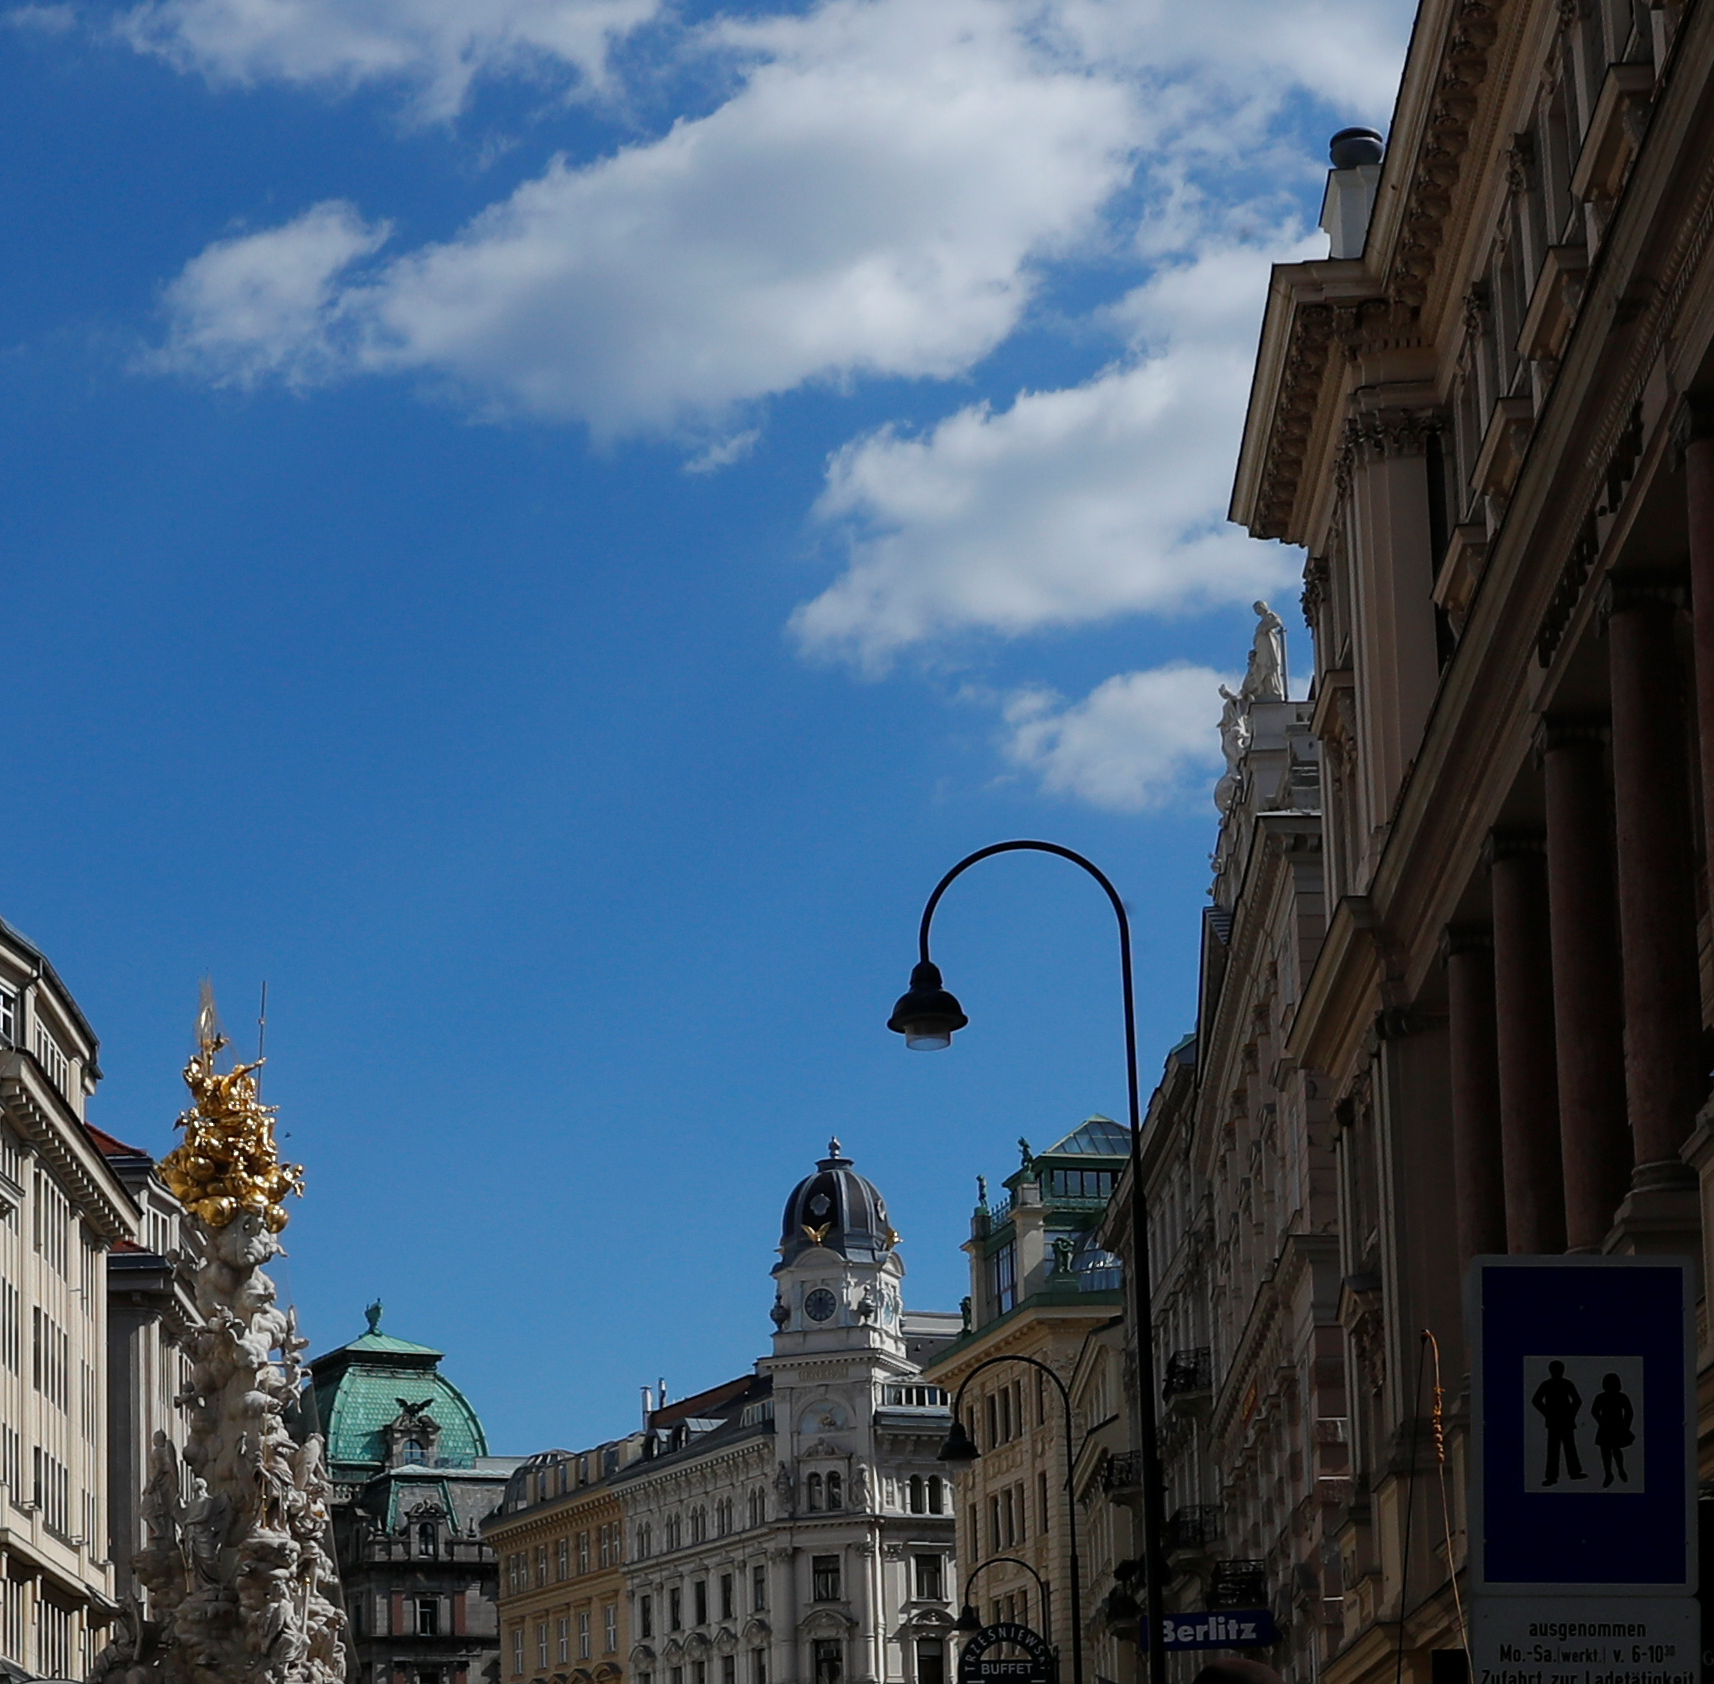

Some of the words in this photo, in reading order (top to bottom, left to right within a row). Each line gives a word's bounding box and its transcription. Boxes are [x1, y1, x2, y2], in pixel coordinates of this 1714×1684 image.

[1162, 1615, 1258, 1643] Berlitz
[1529, 1622, 1646, 1641] ausgenommen
[1613, 1649, 1625, 1663] v.
[981, 1663, 1033, 1675] BUFFET
